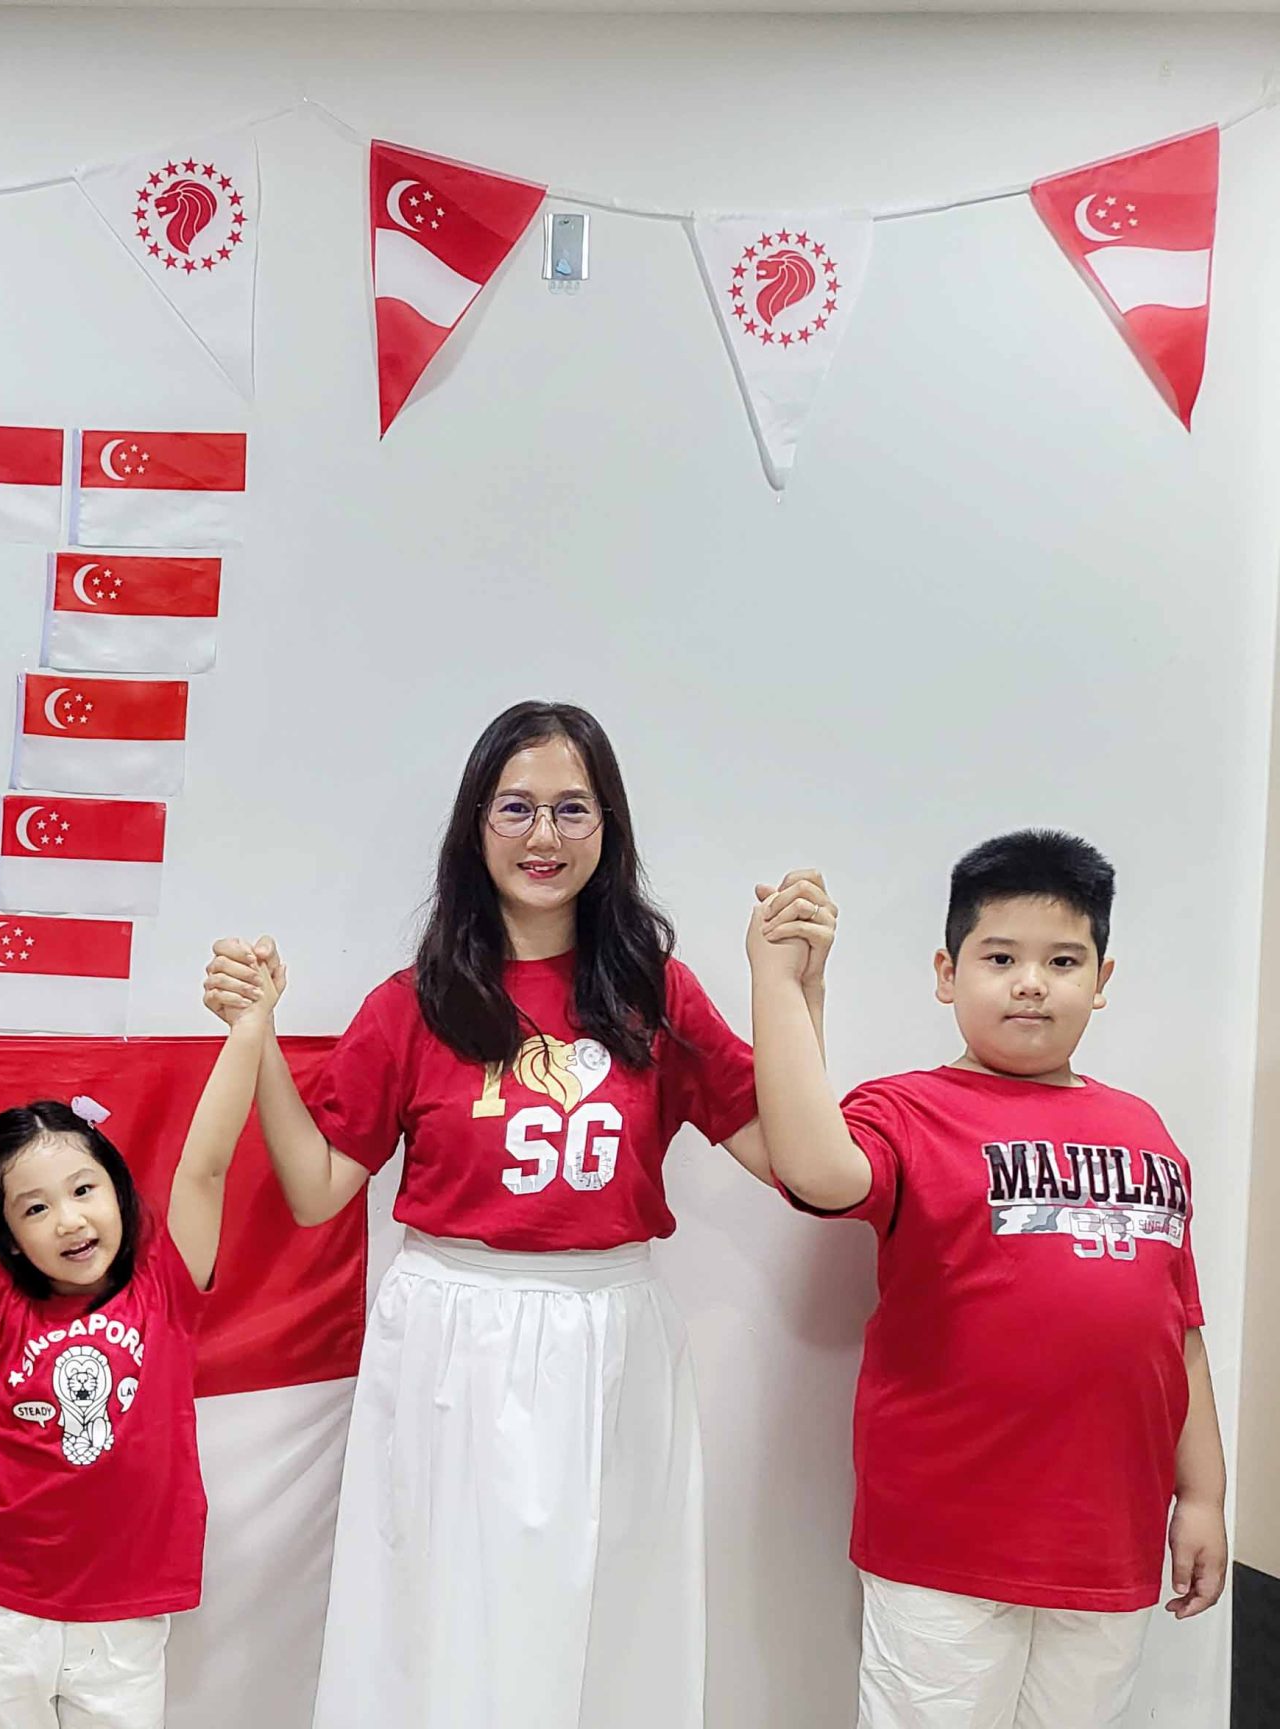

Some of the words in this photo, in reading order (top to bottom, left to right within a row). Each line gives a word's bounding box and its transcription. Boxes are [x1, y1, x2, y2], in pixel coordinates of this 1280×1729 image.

[501, 1102, 623, 1195] SG
[982, 1141, 1187, 1215] MAJULAH
[22, 1313, 145, 1377] SINGAPORE
[18, 1406, 52, 1417] STEADY
